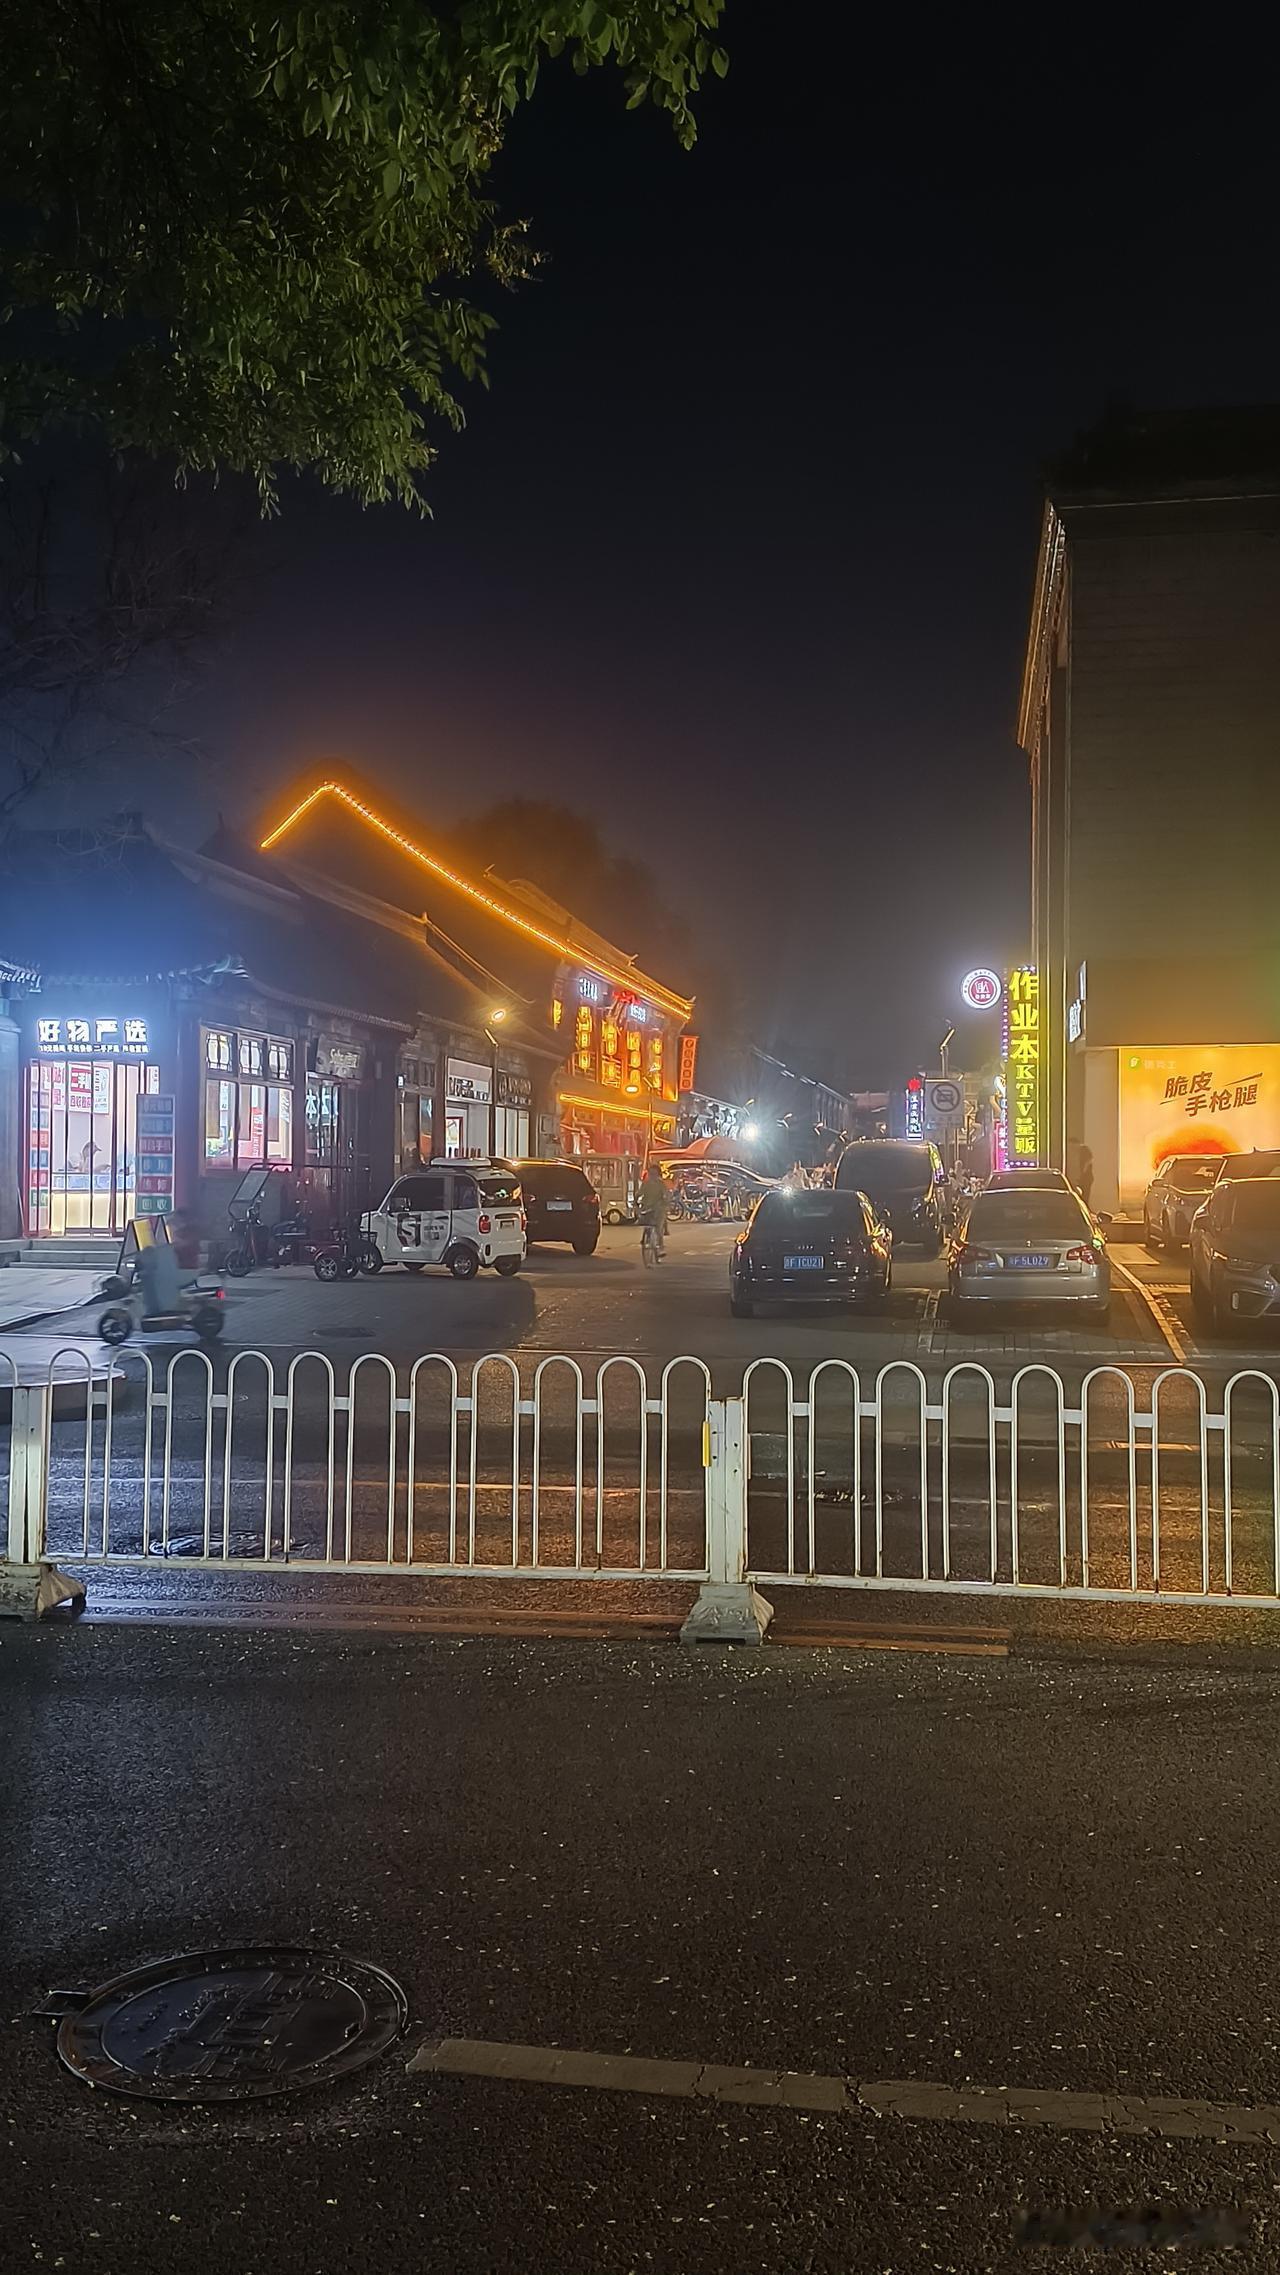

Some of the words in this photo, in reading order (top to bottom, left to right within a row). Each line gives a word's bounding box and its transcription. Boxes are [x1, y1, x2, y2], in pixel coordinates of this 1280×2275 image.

[38, 1019, 147, 1042] 好物严选
[1009, 971, 1038, 1153] 作业本KTV量贩
[1165, 1071, 1213, 1098] 脆皮
[1185, 1084, 1258, 1117] 手枪腿
